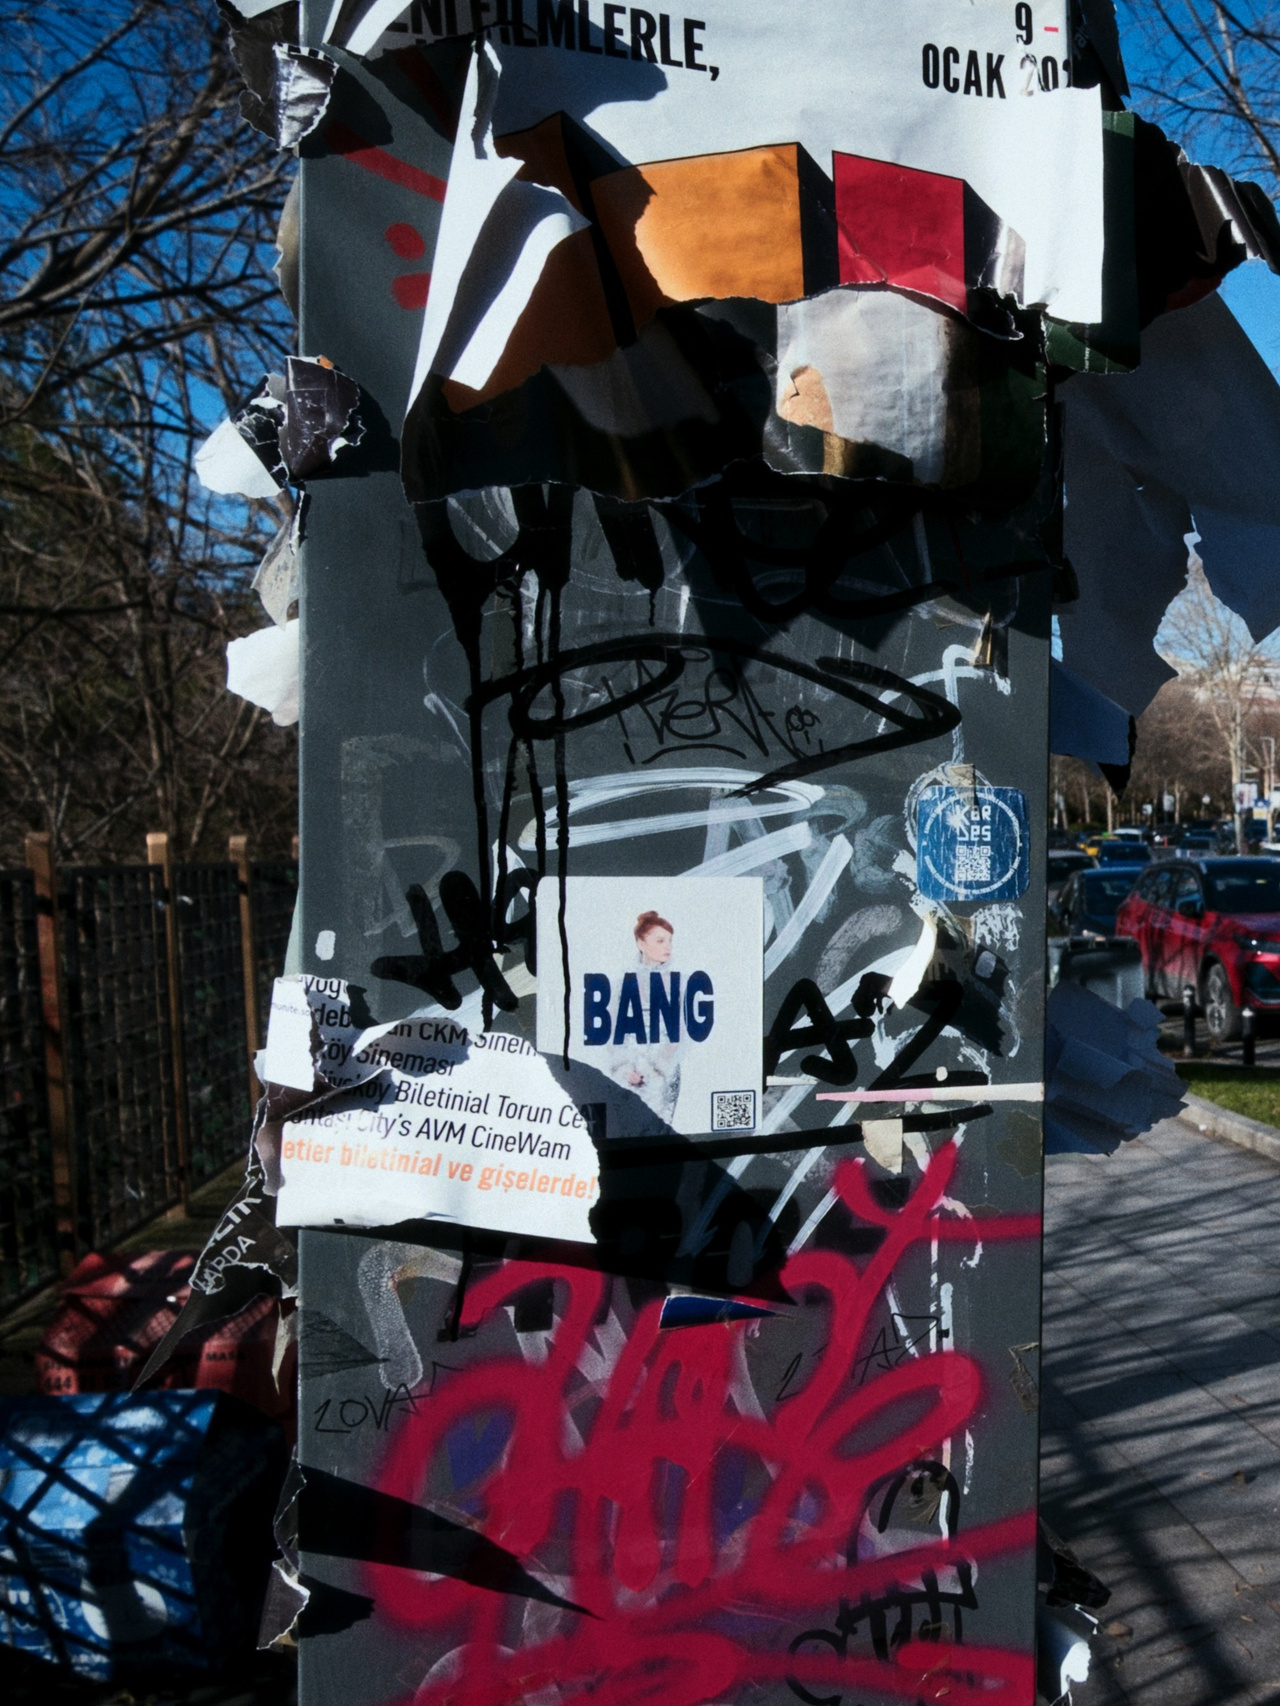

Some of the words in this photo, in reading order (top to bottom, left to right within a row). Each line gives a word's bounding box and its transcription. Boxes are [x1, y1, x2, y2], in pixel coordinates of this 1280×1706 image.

[1015, 2, 1033, 46] 9
[922, 43, 1007, 99] OCAK
[584, 970, 714, 1046] BANG
[419, 1022, 469, 1047] CKM
[394, 1080, 490, 1116] Biletinial
[498, 1094, 553, 1125] Torun
[558, 1104, 588, 1129] Ce
[415, 1117, 467, 1146] AVM
[470, 1124, 572, 1161] CineWam
[339, 1141, 443, 1177] biletinial
[448, 1159, 474, 1182] ve
[476, 1162, 598, 1200] gişelerde!
